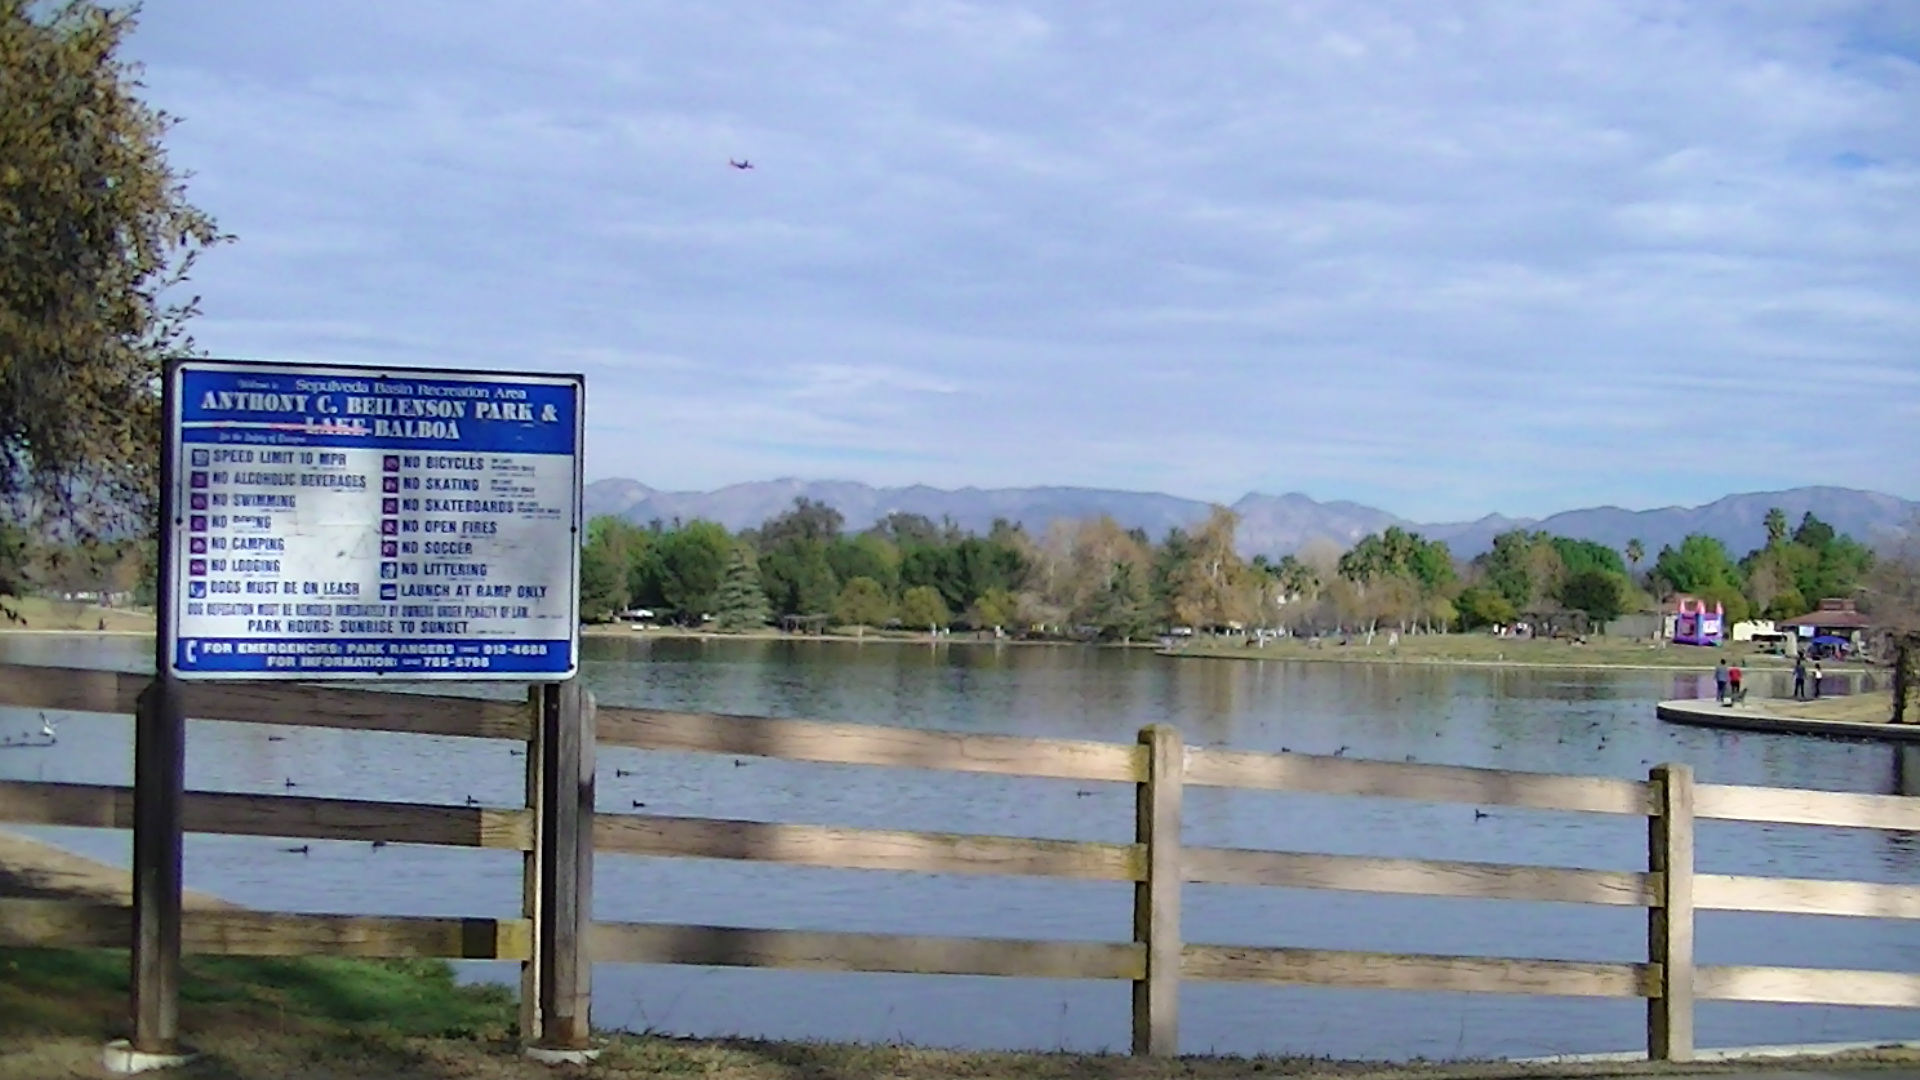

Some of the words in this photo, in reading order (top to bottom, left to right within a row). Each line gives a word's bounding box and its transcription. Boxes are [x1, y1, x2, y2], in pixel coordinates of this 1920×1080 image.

[296, 380, 369, 393] Sepulveda
[374, 383, 413, 395] Basin
[418, 385, 489, 398] Recreation
[493, 387, 526, 399] Area
[201, 391, 309, 412] ANTHONY
[317, 395, 338, 413] C.
[346, 397, 465, 418] BEILENSON
[475, 402, 534, 420] PARK
[541, 404, 558, 422] &
[305, 417, 366, 436] LAKE
[375, 419, 460, 439] BALBOA
[213, 450, 254, 463] SPEED
[260, 451, 294, 464] LIMIT
[301, 452, 313, 464] 10
[404, 456, 420, 468] NO
[426, 456, 484, 470] BICYCLES
[213, 471, 228, 484] NO
[234, 472, 295, 486] ALCOHOLIC
[301, 474, 366, 488] BEVERAGES
[404, 478, 420, 490] NO
[426, 478, 479, 491] SKATING
[212, 493, 227, 506] NO
[233, 494, 296, 508] SWIMMING
[403, 499, 419, 511] NO
[425, 499, 514, 513] SKATEBOARDS
[212, 515, 227, 528] NO
[402, 520, 418, 532] NO
[425, 520, 456, 533] OPEN
[462, 521, 497, 534] FIRES
[212, 537, 227, 550] NO
[233, 537, 284, 551] CAMPING
[402, 542, 418, 554] NO
[425, 542, 472, 555] SOCCER
[211, 559, 227, 572] NO
[402, 563, 418, 575] NO
[424, 563, 487, 577] LITTERING
[211, 581, 241, 594] DOGS
[247, 581, 279, 594] MUST
[284, 581, 297, 594] BE
[303, 582, 318, 594] ON
[323, 582, 359, 595] LEASH
[401, 584, 450, 597] LAUNCH
[456, 585, 471, 597] AT
[477, 585, 511, 598] RAMP
[517, 585, 547, 598] ONLY
[248, 620, 281, 632] PARK
[288, 620, 333, 633] HOURS:
[340, 620, 393, 633] SUNRISE
[400, 621, 414, 633] TO
[421, 621, 469, 634] SUNSET
[203, 643, 232, 654] FOR
[347, 643, 384, 654] PARK
[389, 644, 454, 655] RANGERS
[266, 656, 296, 667] FOR
